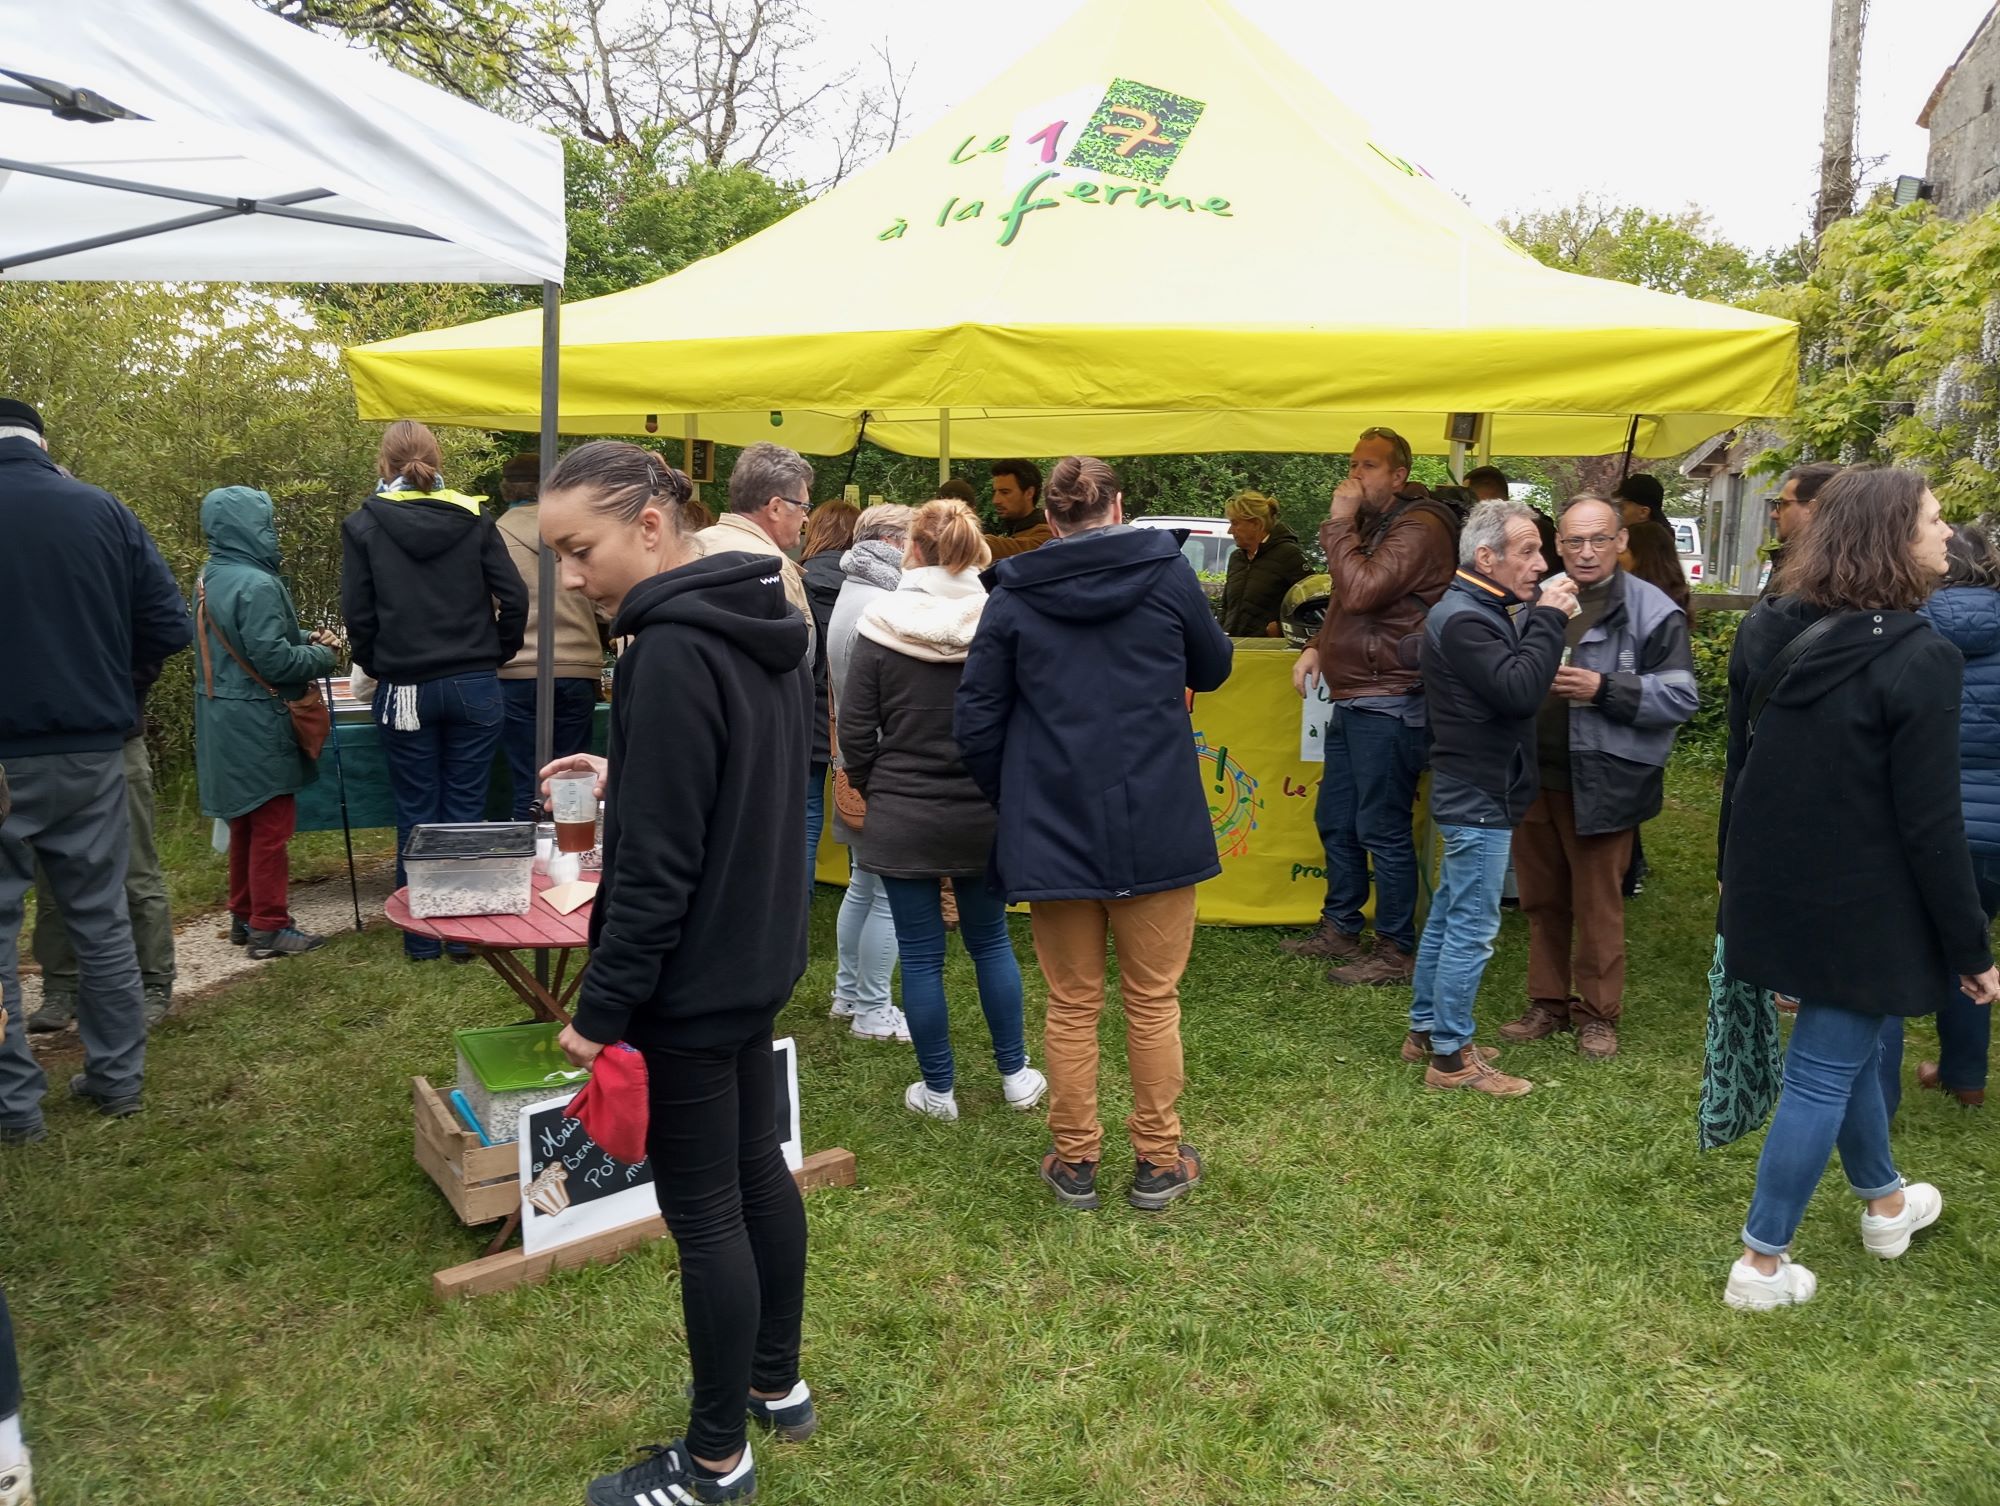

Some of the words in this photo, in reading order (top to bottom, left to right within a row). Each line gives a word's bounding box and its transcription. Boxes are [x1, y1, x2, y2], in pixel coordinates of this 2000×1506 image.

[949, 132, 1010, 164] Le
[878, 218, 908, 241] à
[936, 197, 984, 227] la
[996, 170, 1234, 247] ferme
[1283, 776, 1307, 798] Le
